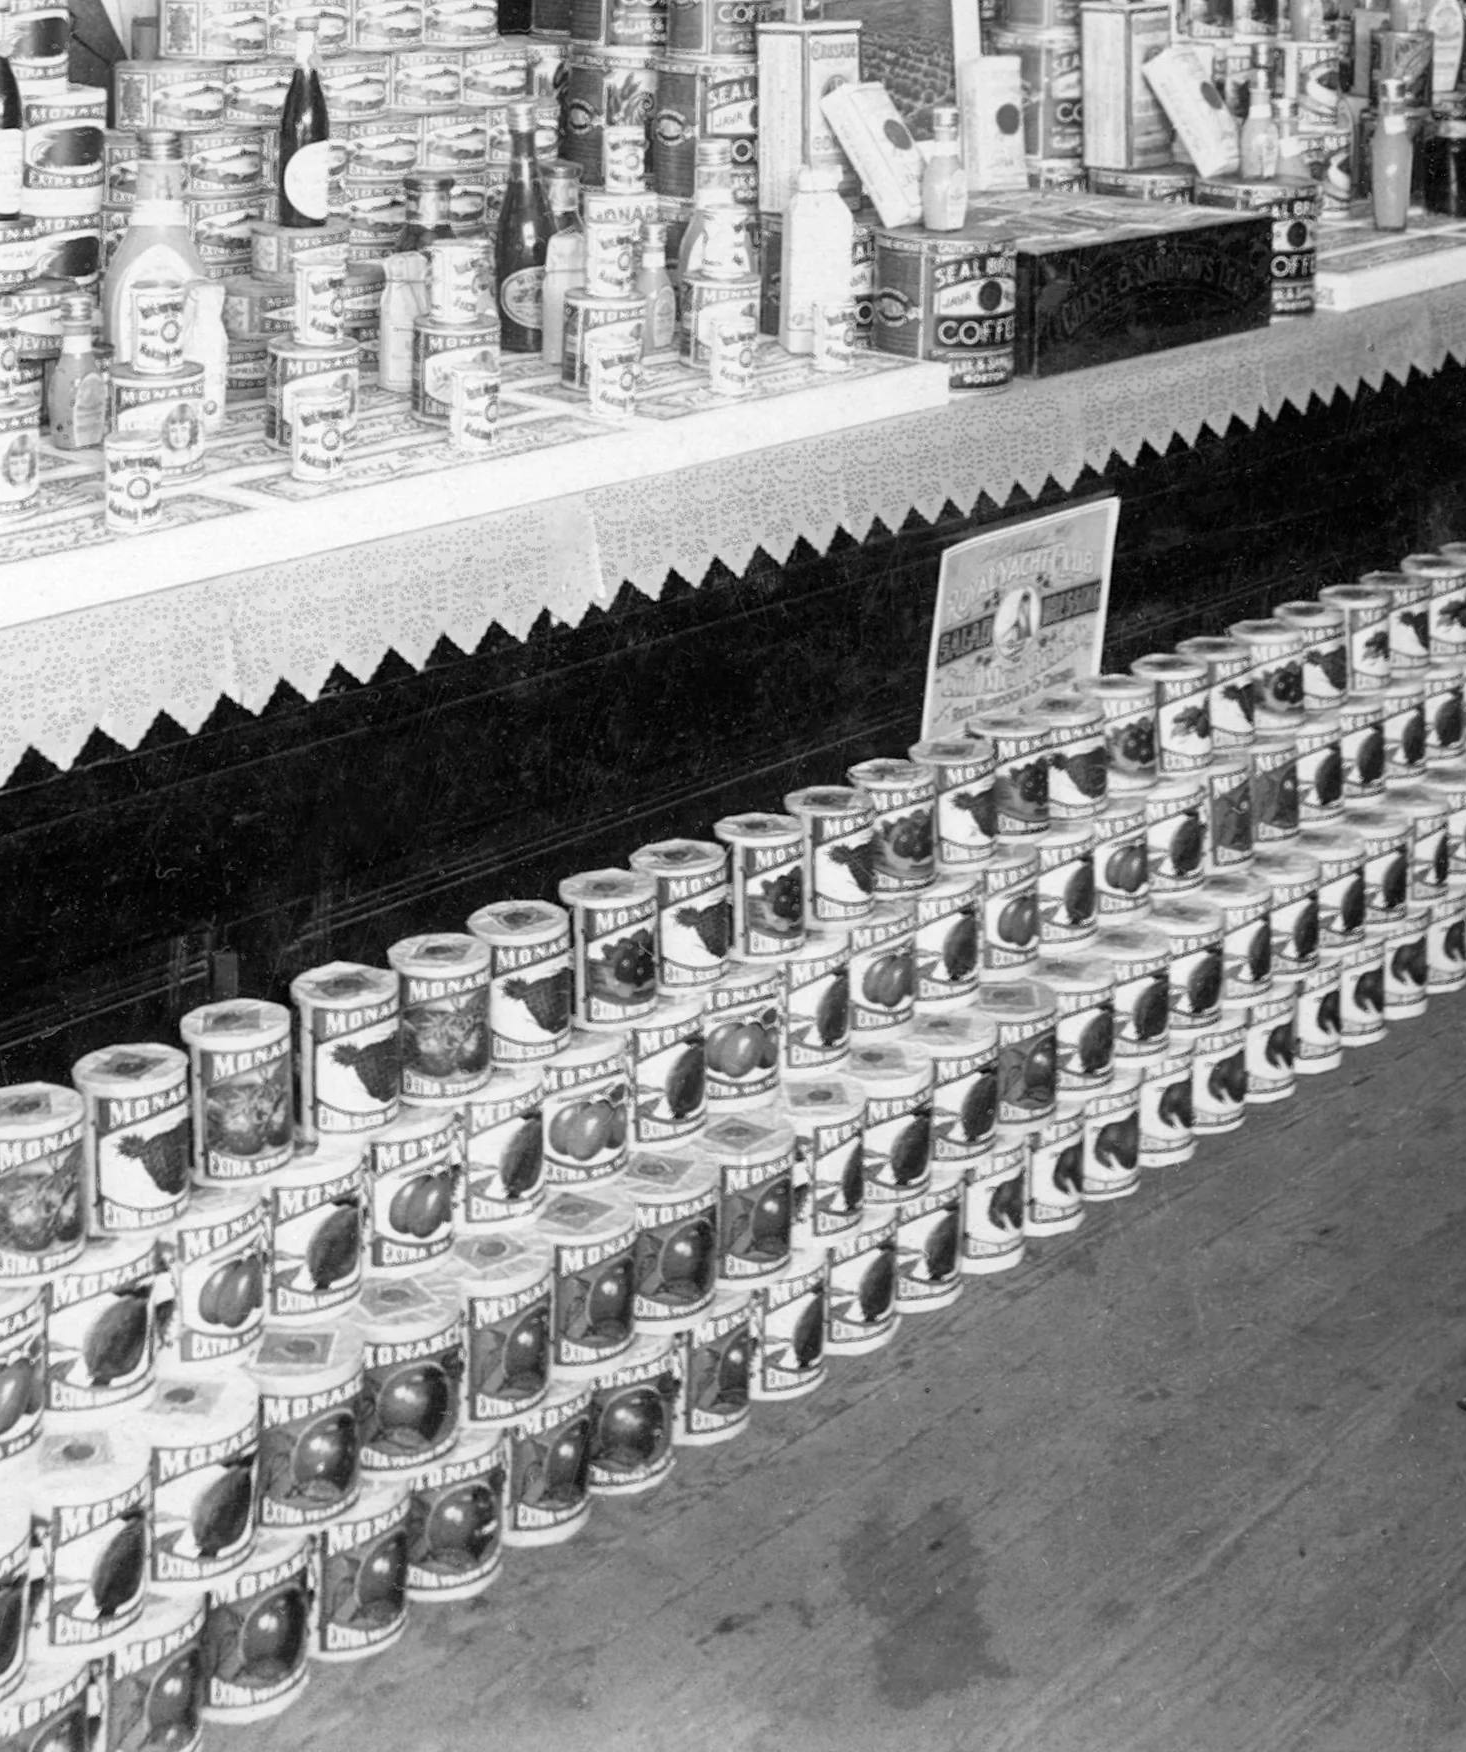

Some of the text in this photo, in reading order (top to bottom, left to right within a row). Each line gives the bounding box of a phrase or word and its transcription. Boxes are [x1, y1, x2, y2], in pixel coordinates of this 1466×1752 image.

[934, 259, 981, 289] SEAL
[998, 549, 1052, 582] YACHT
[1053, 543, 1094, 580] CLUB
